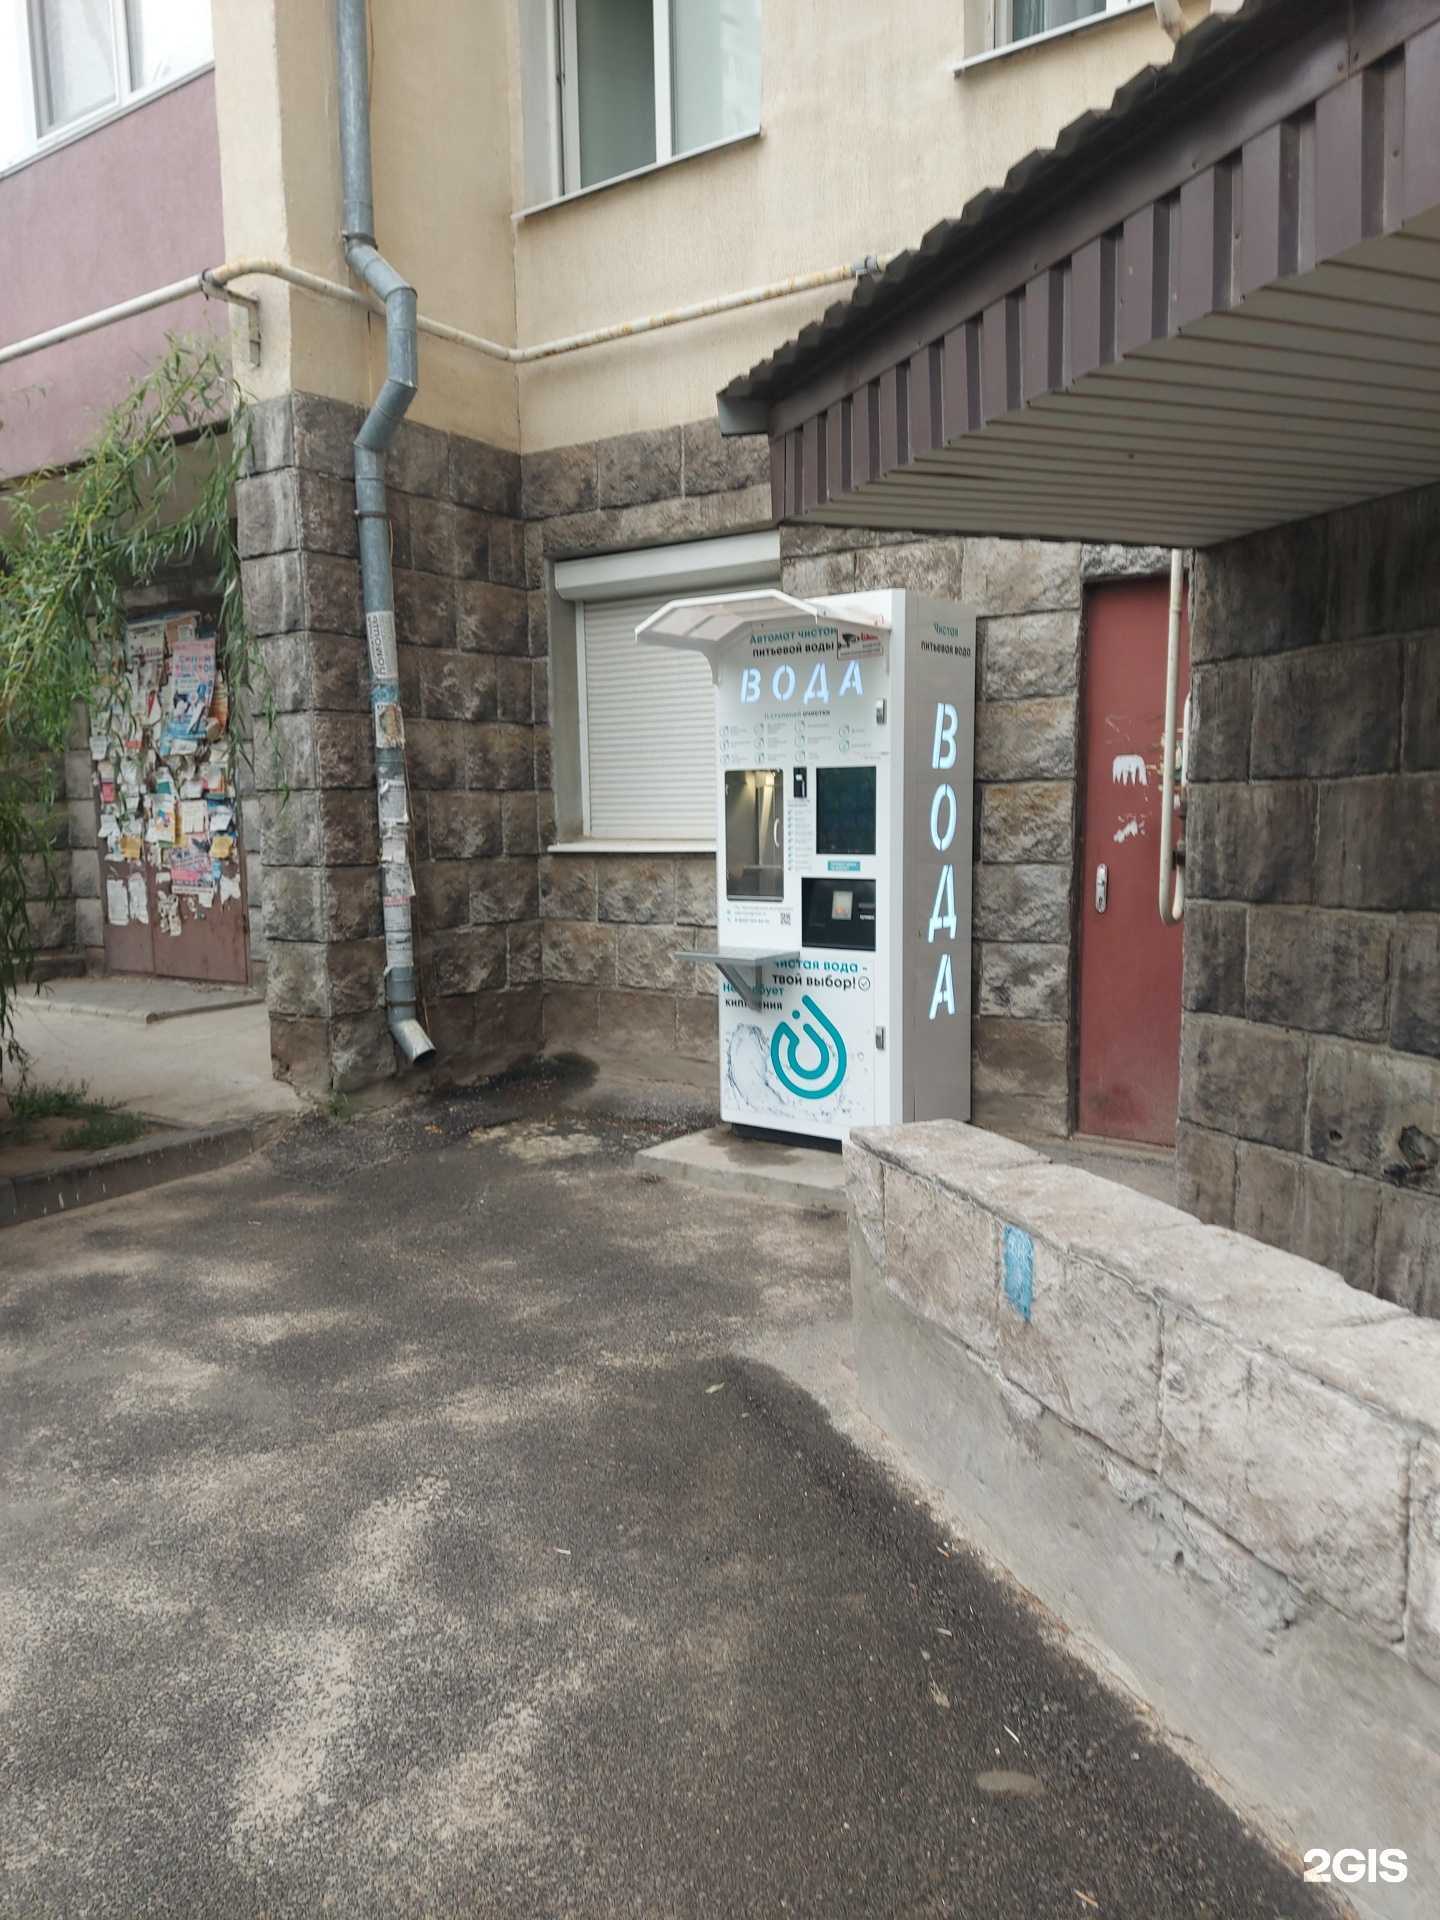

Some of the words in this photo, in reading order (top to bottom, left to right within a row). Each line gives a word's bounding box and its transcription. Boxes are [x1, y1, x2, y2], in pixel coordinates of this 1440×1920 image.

[750, 631, 794, 645] Автомат
[752, 642, 802, 657] питьевой
[805, 641, 834, 654] воды
[740, 660, 864, 705] ВОДА
[928, 702, 959, 1020] ВОДА
[823, 961, 858, 973] вода
[771, 972, 802, 986] твой
[806, 974, 856, 990] выбор!
